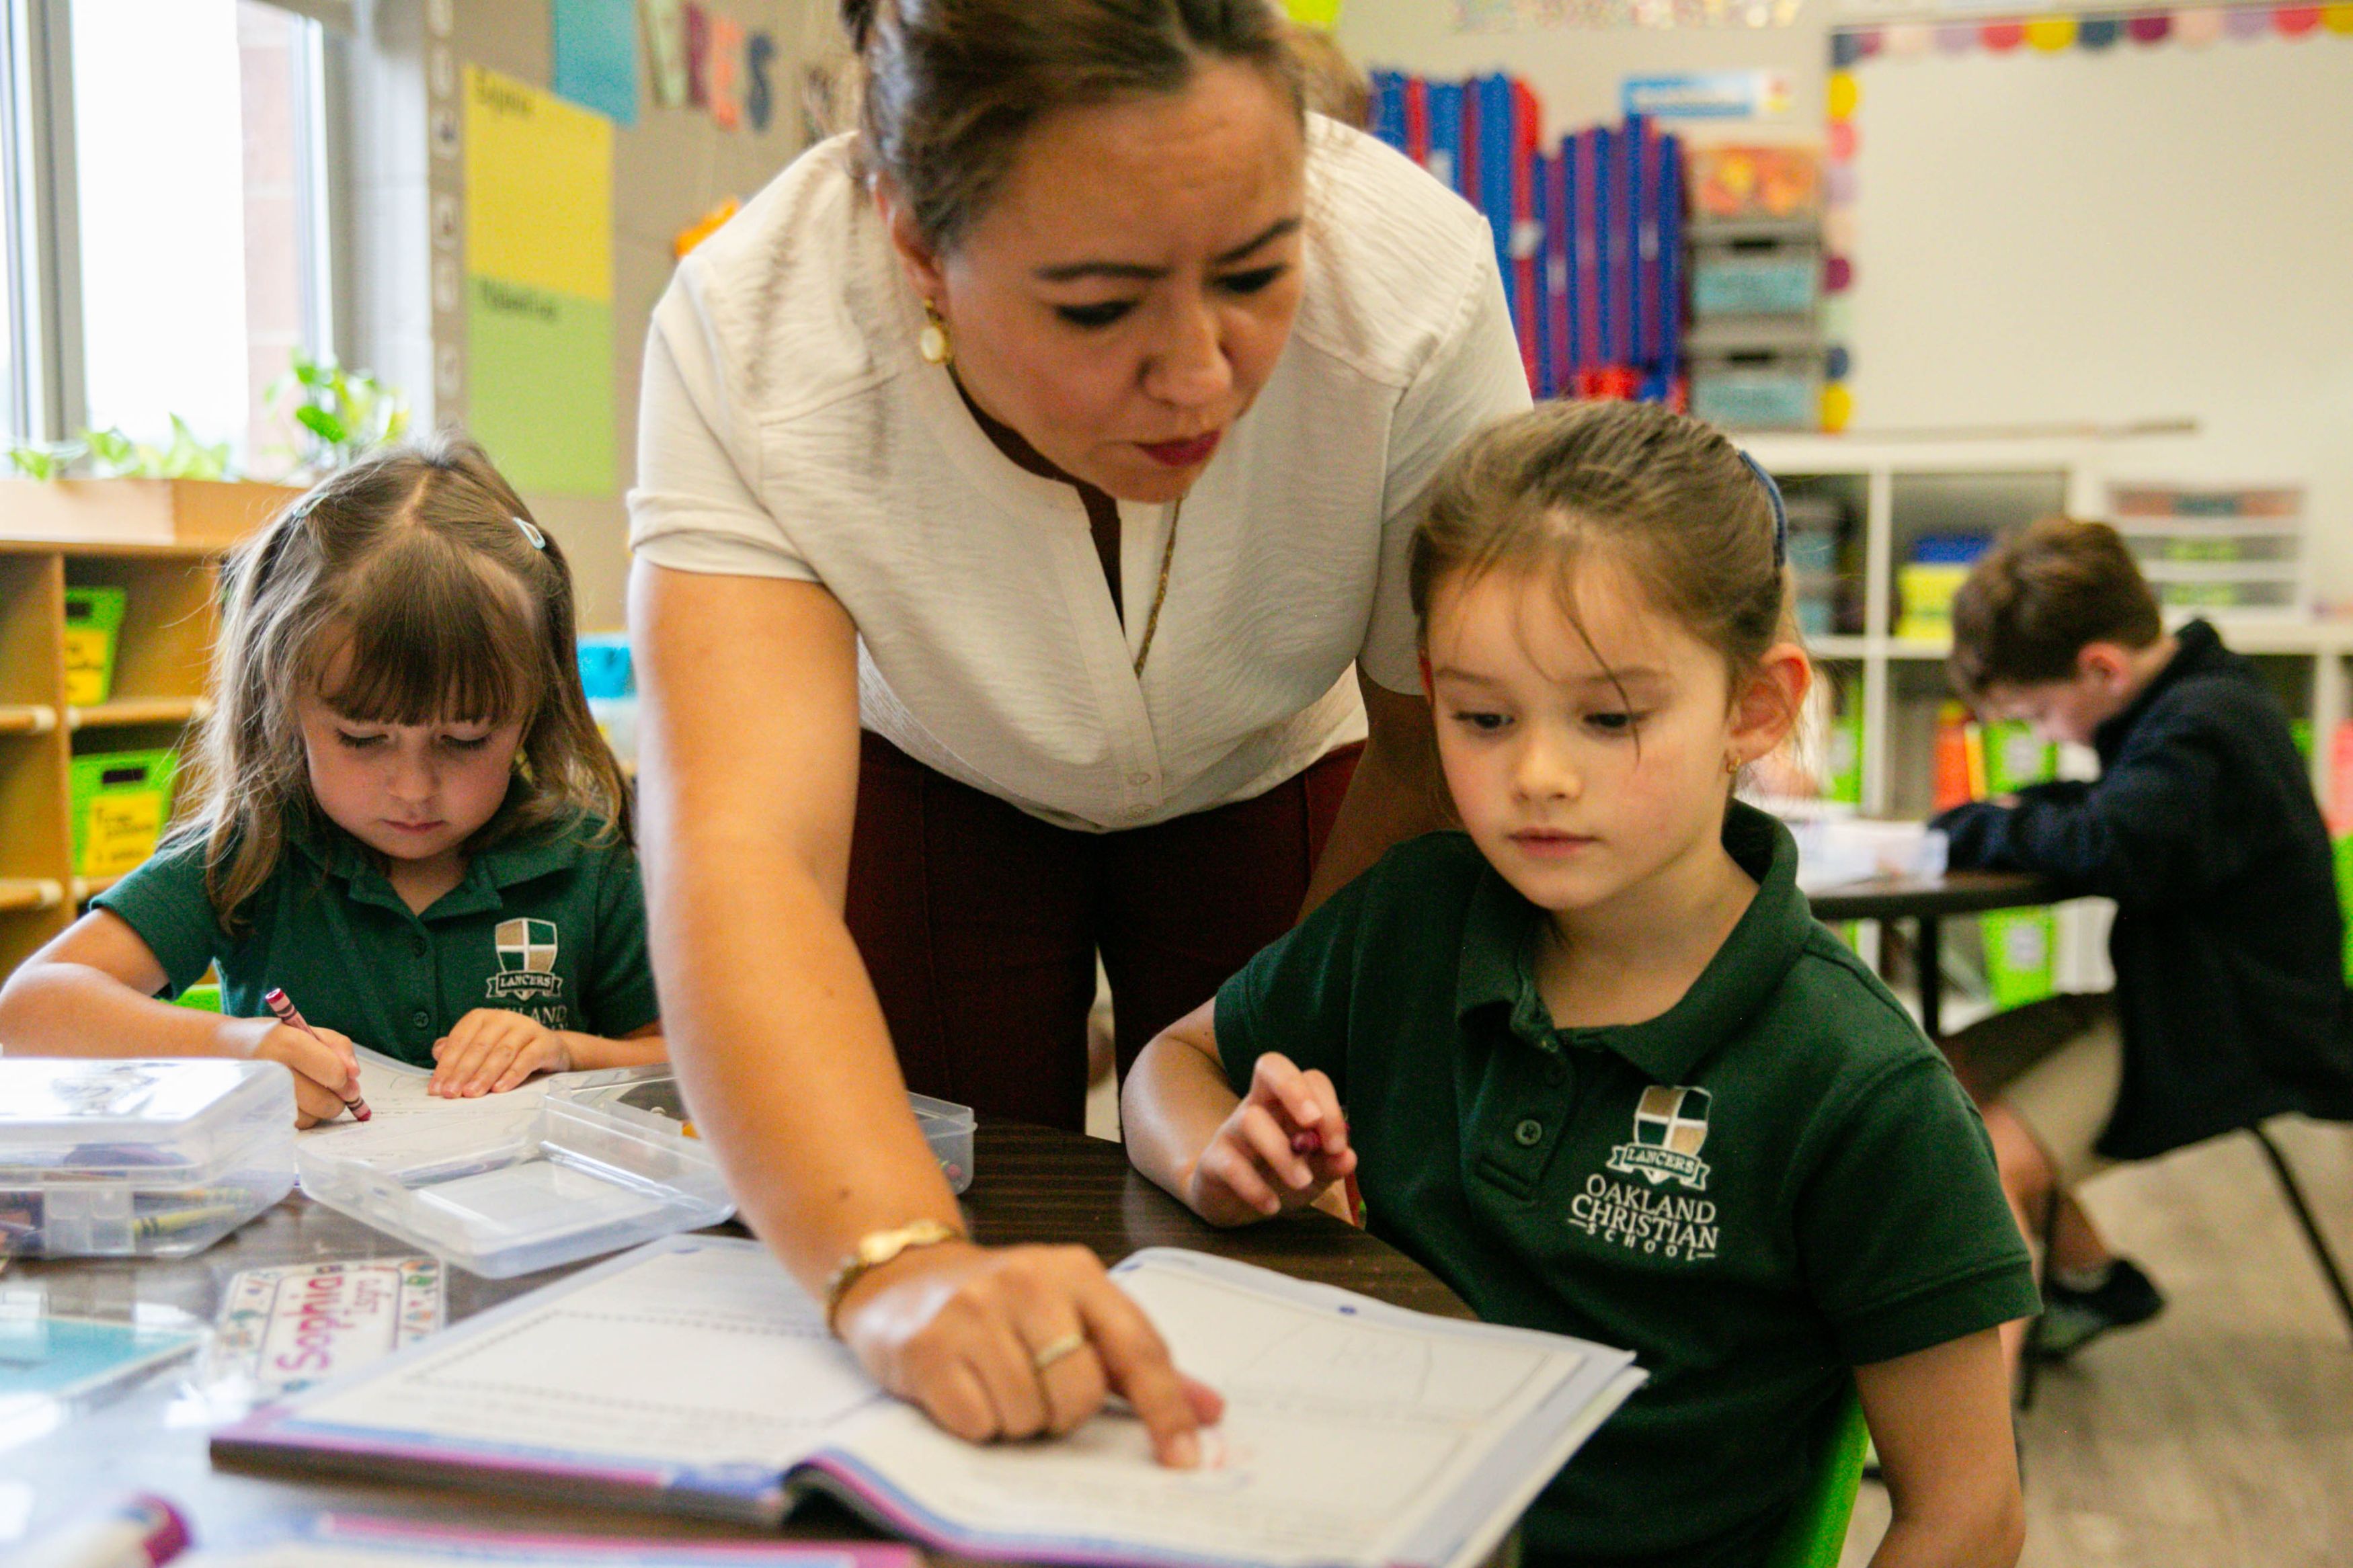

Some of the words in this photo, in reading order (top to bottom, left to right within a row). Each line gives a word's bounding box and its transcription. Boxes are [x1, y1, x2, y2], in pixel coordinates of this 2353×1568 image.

[500, 975, 551, 987] LANCERS
[1627, 1147, 1695, 1174] LANCERS
[1586, 1173, 1716, 1224] OAKLAND
[1571, 1194, 1720, 1250] CHRISTIAN
[1587, 1223, 1694, 1262] SCHOOL
[275, 1276, 354, 1371] Sophia
